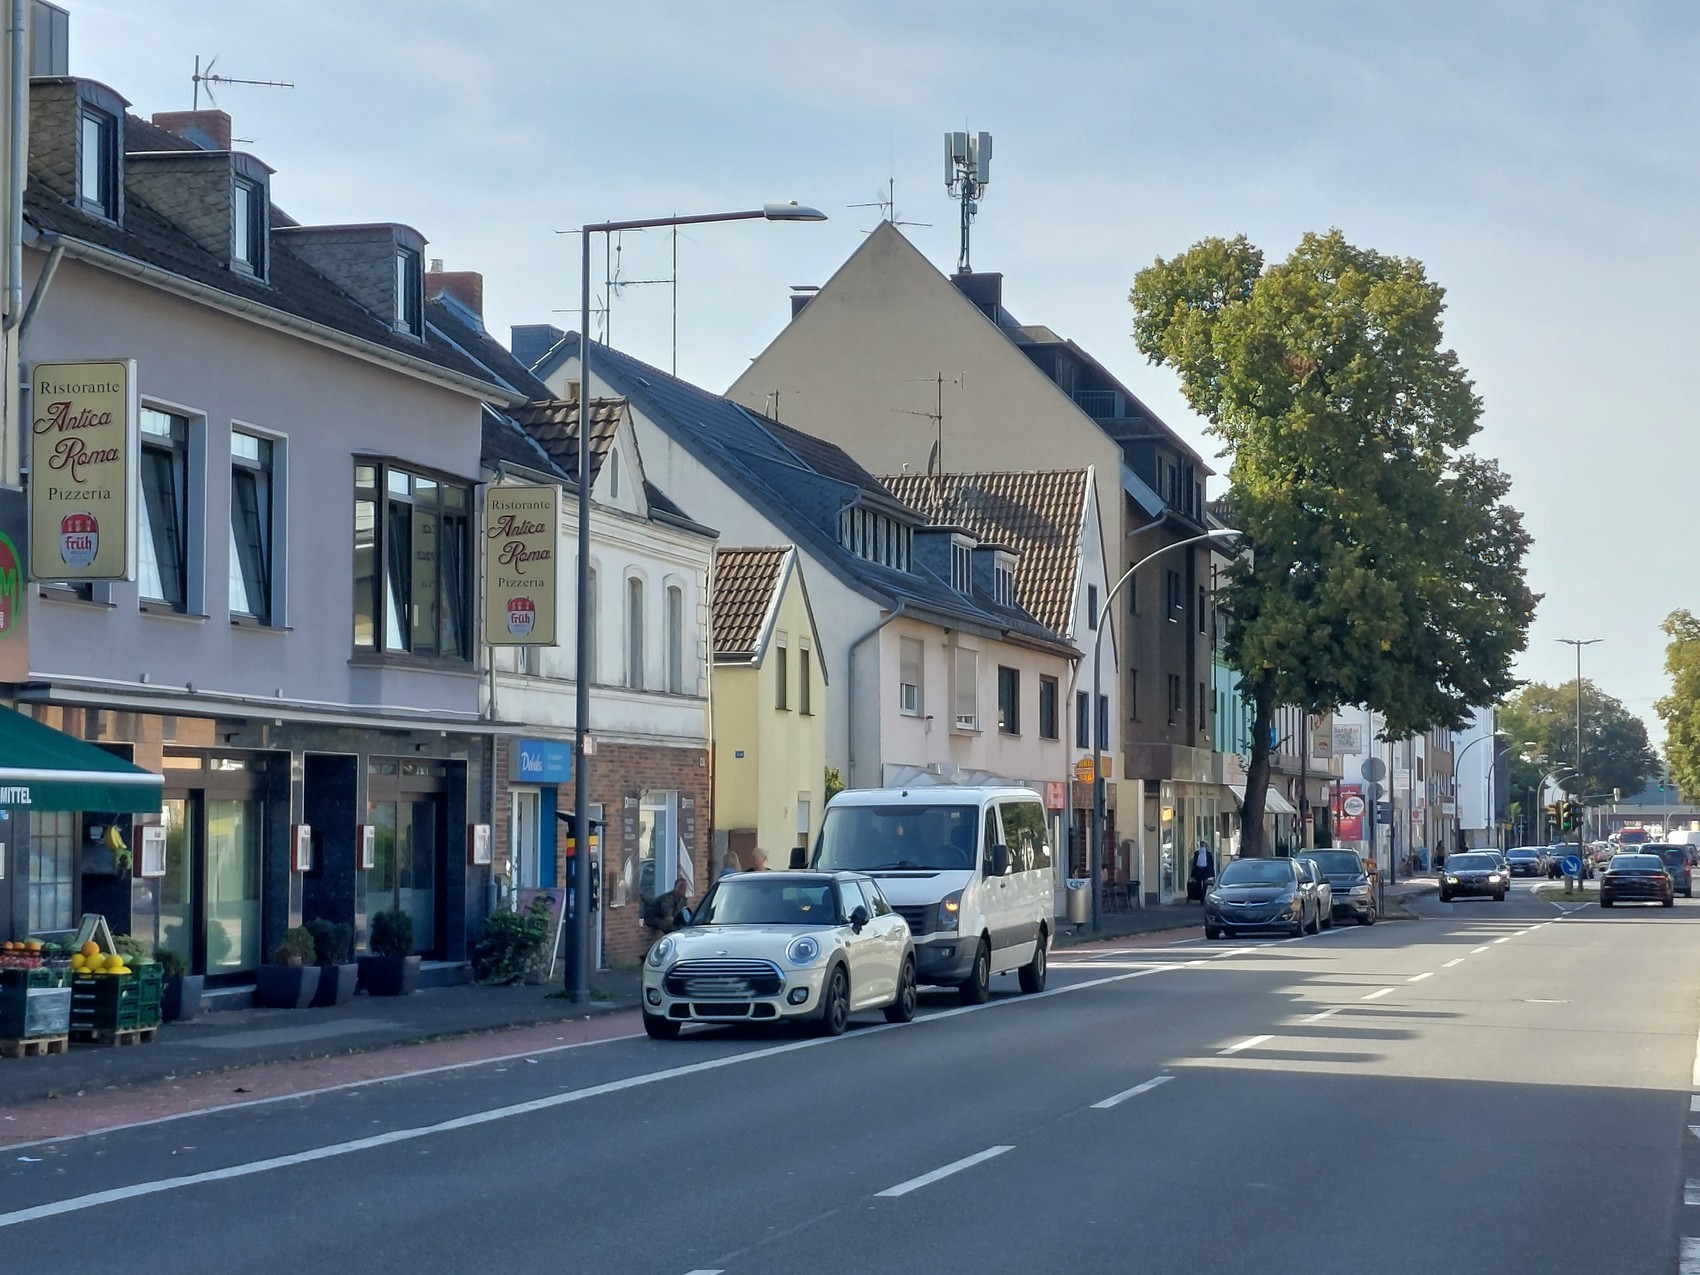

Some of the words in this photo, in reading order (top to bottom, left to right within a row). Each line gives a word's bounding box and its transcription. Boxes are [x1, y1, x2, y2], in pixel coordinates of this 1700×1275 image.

[40, 381, 121, 395] Ristorante
[33, 401, 112, 435] Antica
[49, 437, 119, 484] Roma
[48, 487, 111, 501] Pizzeria
[491, 499, 551, 511] Ristorante
[487, 514, 546, 540] Antica
[498, 541, 552, 575] Roma
[498, 577, 544, 588] Pizzeria
